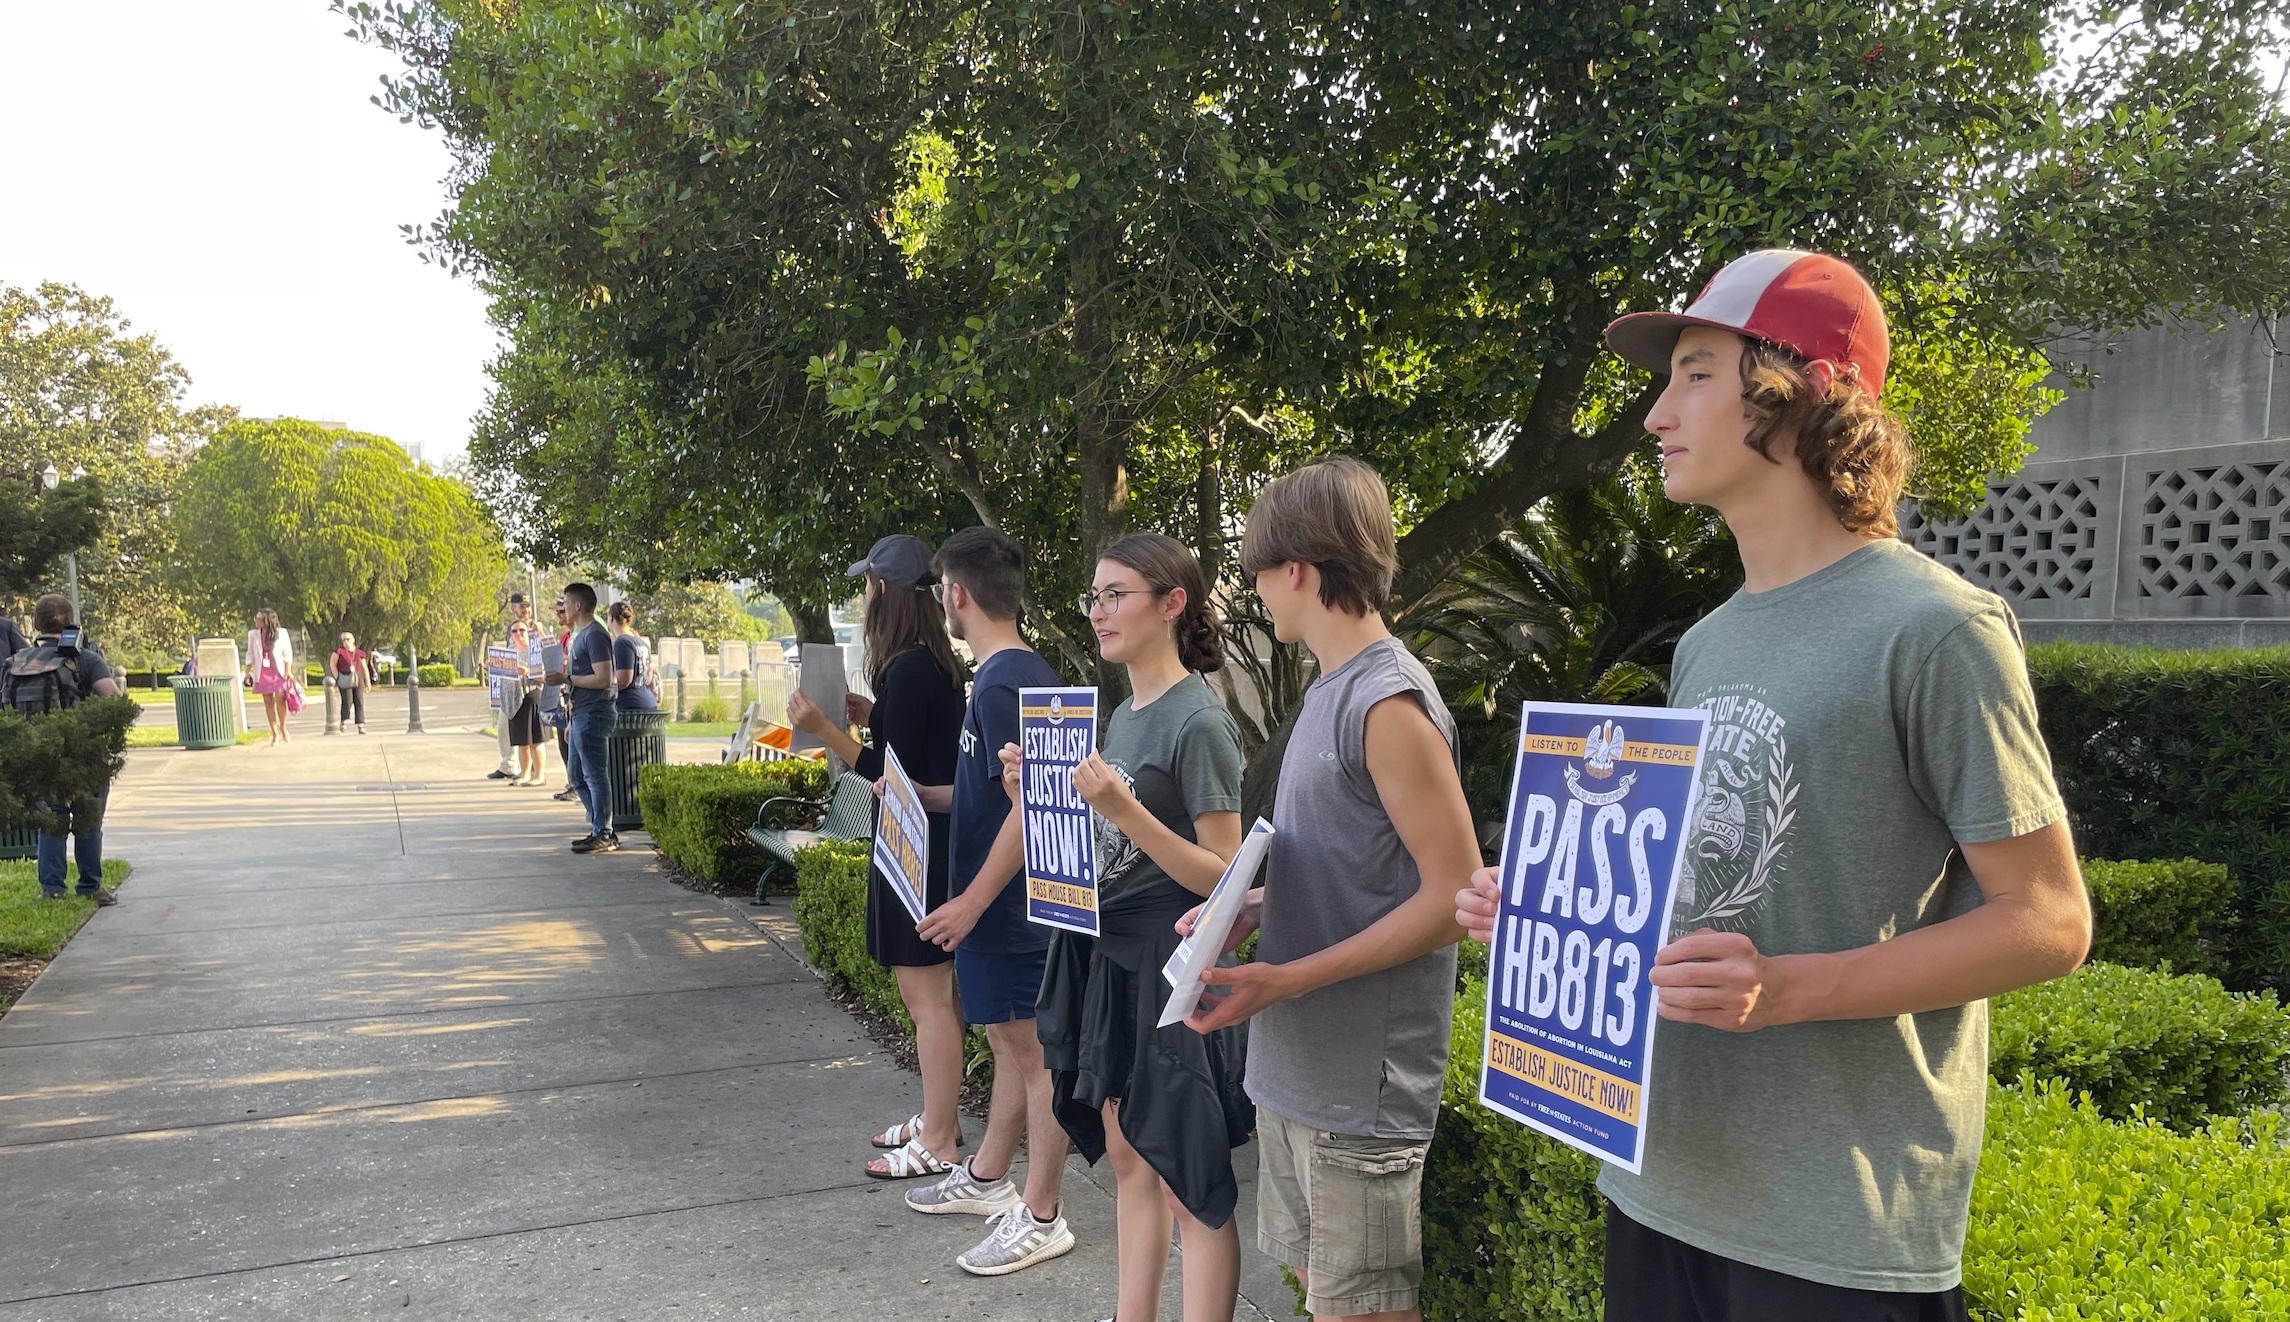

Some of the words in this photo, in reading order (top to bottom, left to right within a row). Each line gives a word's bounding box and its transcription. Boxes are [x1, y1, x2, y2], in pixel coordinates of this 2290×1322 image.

[1025, 726, 1088, 762] ESTABLISH
[1531, 739, 1563, 751] LISTEN
[1566, 741, 1579, 752] TO
[1628, 746, 1648, 758] THE
[1651, 748, 1692, 761] PEOPLE
[1721, 763, 1738, 785] HEAL
[881, 804, 900, 860] PASS
[902, 834, 923, 898] HB813
[1028, 809, 1091, 881] NOW!
[1510, 793, 1667, 934] PASS
[1033, 880, 1047, 899] PASS
[1048, 883, 1066, 903] HOUSE
[1068, 887, 1081, 906] BILL
[1082, 890, 1092, 908] 813
[1672, 913, 1685, 923] 020
[1501, 914, 1641, 1047] HB813
[1499, 1015, 1511, 1026] THE
[1511, 1021, 1539, 1036] ABOLITION
[1539, 1030, 1548, 1038] OF
[1547, 1033, 1576, 1049] ABORTION
[1576, 1042, 1584, 1052] IN
[1585, 1044, 1618, 1064] LOUISIANA
[1618, 1058, 1633, 1069] ACT
[1491, 1038, 1546, 1082] ESTABLISH
[1549, 1061, 1597, 1102] JUSTICE
[1599, 1079, 1634, 1117] NOW!
[1508, 1092, 1520, 1101] PAID
[1520, 1096, 1530, 1106] FOR
[1531, 1101, 1537, 1109] BY
[1537, 1103, 1550, 1115] FREE
[1554, 1110, 1572, 1124] STATES
[1572, 1119, 1593, 1133] ACTION
[1593, 1128, 1610, 1140] FUND
